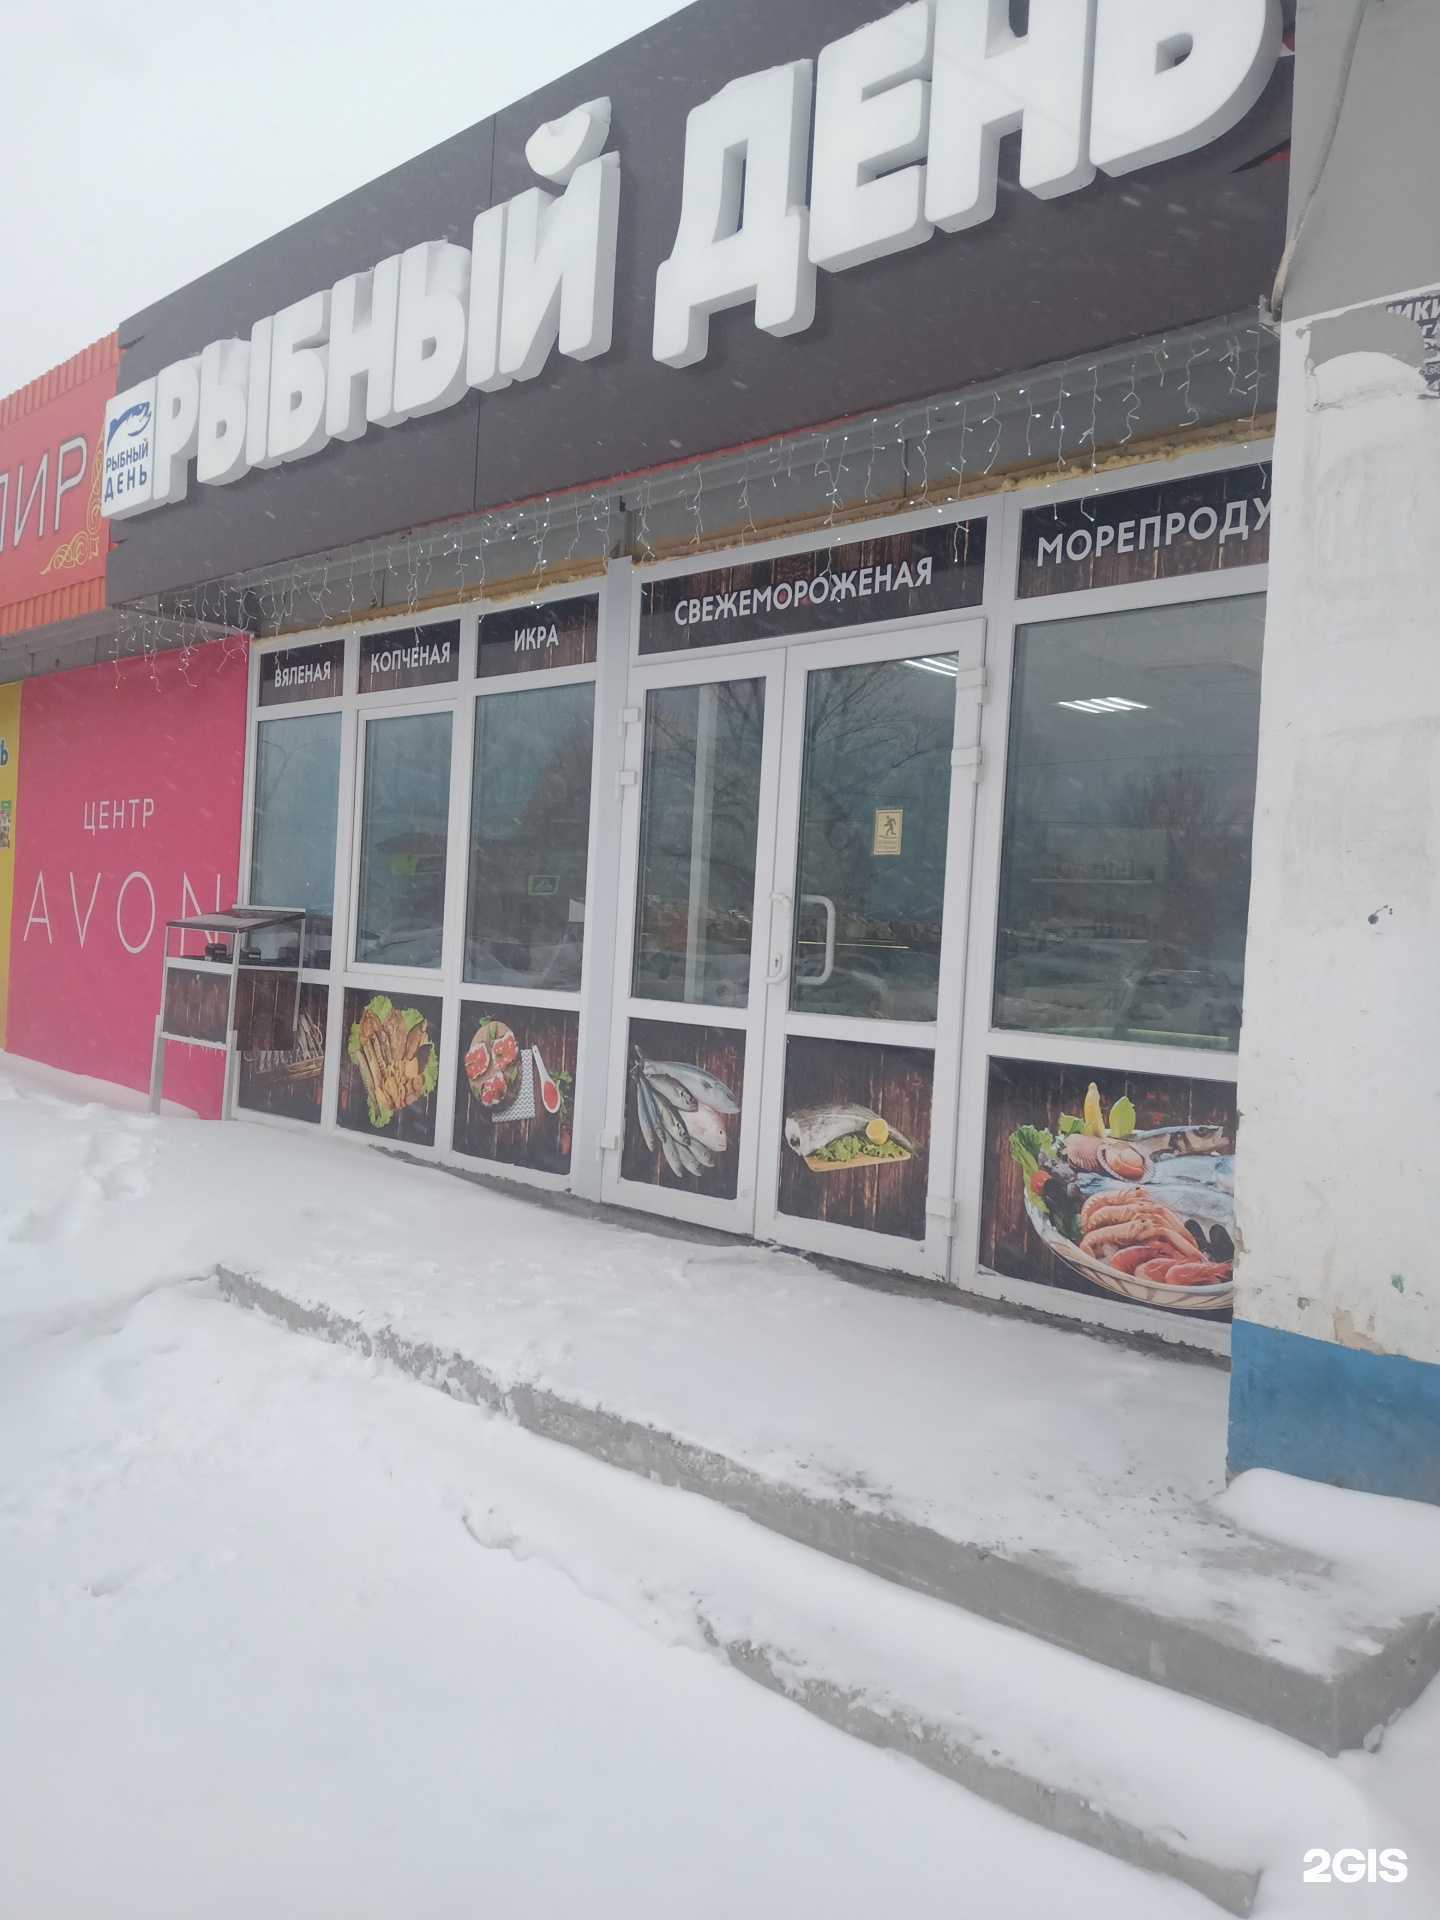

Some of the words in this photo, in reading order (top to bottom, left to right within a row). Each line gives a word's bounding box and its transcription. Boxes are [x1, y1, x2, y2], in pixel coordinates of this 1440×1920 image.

[154, 97, 621, 501] РЫБНЫЙ
[653, 0, 1283, 368] ДЕНЬ
[106, 438, 149, 473] РЫБНЫЙ
[104, 464, 148, 502] ДЕНЬ
[674, 556, 934, 626] СВЕЖЕМОРОЖЕНАЯ
[513, 624, 559, 652] ИКРА
[274, 660, 331, 688] ВЯЛЕНАЯ
[83, 798, 154, 835] ЦЕНТР
[23, 870, 221, 957] AVON
